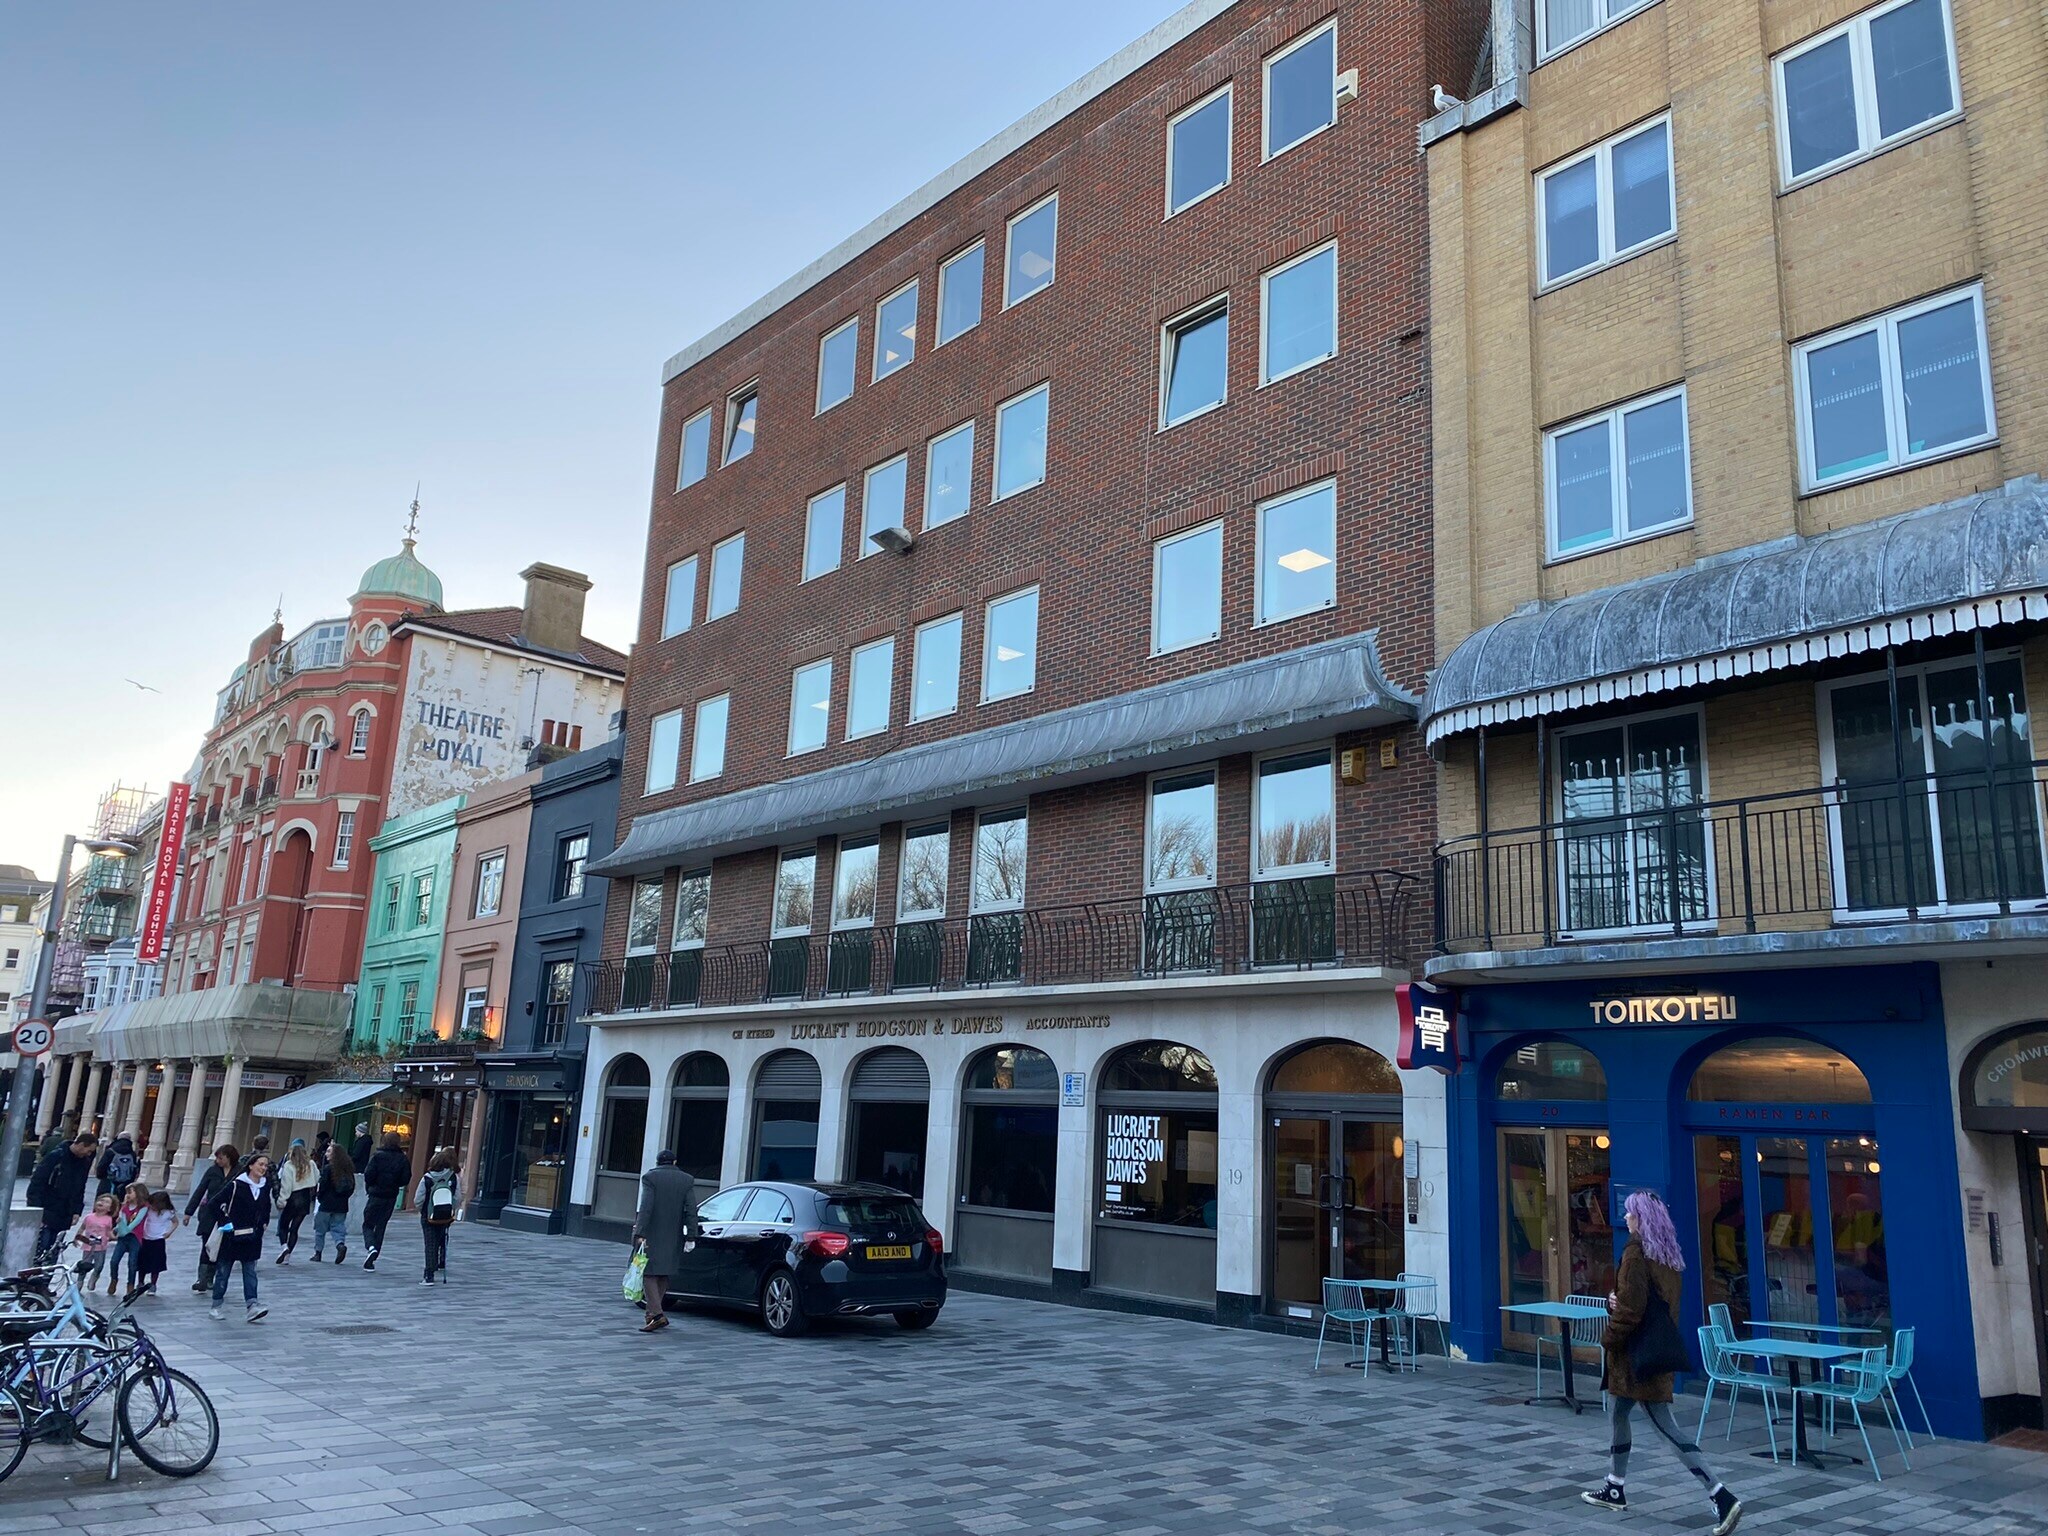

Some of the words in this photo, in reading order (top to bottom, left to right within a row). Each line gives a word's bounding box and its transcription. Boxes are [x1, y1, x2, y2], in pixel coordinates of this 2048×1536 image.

[418, 701, 505, 739] THEATRE
[168, 788, 184, 843] THEATRE
[160, 846, 173, 886] ROYAL
[146, 890, 165, 954] BRIGHTON
[1590, 996, 1736, 1024] TONKOTSU
[19, 1029, 47, 1045] 20
[790, 1022, 849, 1039] LUCRAFT
[856, 1018, 927, 1037] HODGSON
[933, 1018, 944, 1035] &
[951, 1016, 1002, 1034] DAWES
[1025, 1015, 1110, 1030] ACCOUNTANTS
[1541, 1105, 1559, 1117] 20
[1719, 1107, 1784, 1120] RAMEN
[1794, 1109, 1831, 1121] BAR
[1108, 1115, 1160, 1138] LUCRAFT
[1107, 1137, 1163, 1162] HODGSON
[1106, 1159, 1146, 1184] DAWES
[1229, 1168, 1242, 1185] 19
[1419, 1180, 1434, 1198] 19
[871, 1247, 889, 1257] AA13
[891, 1246, 906, 1257] AND
